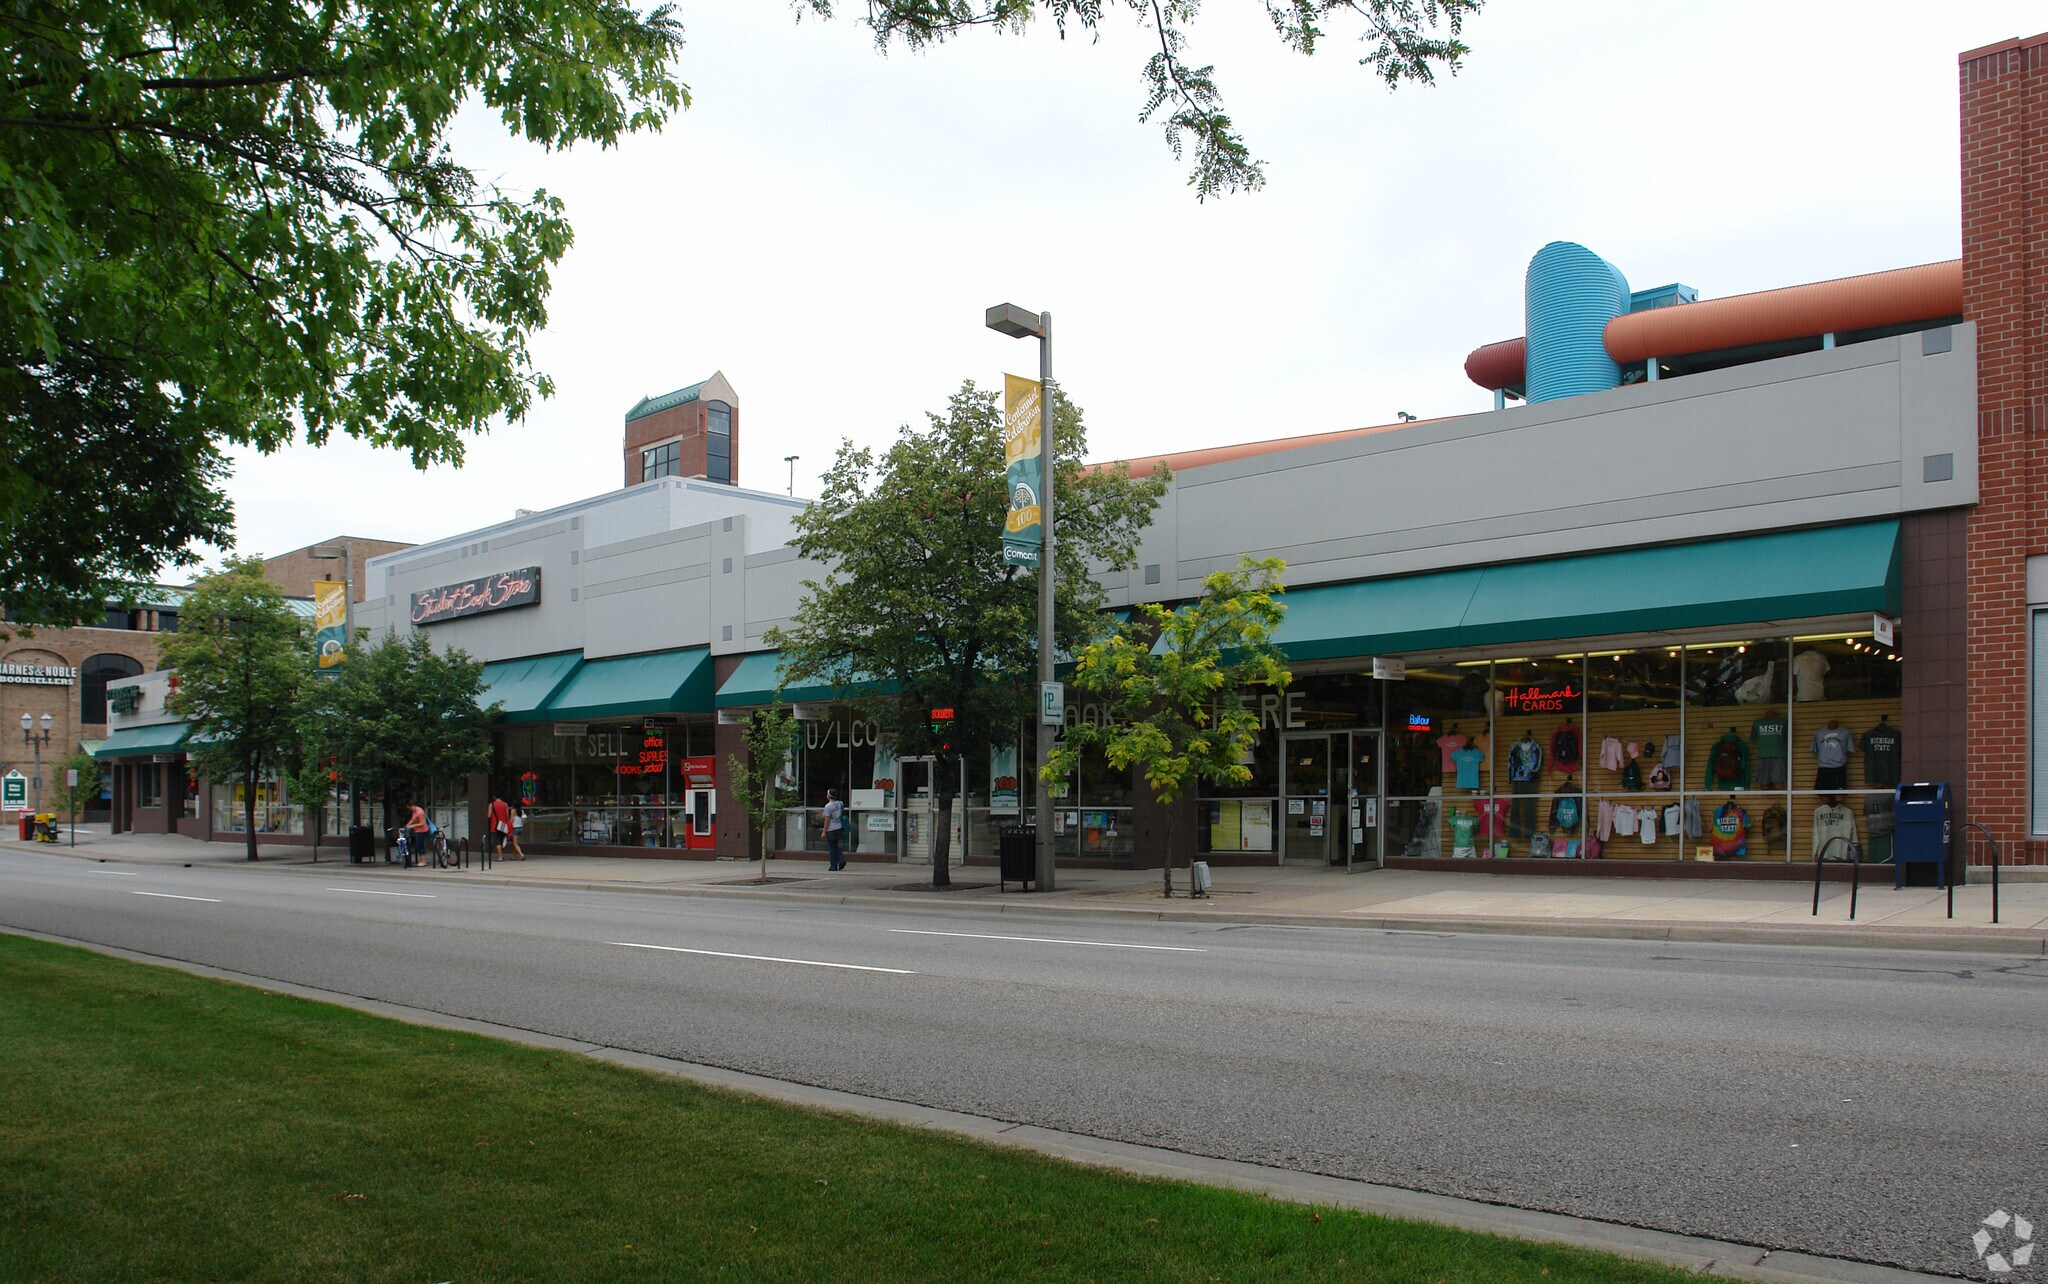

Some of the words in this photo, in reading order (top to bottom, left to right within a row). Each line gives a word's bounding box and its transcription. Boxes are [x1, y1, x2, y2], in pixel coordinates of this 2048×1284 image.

[1006, 386, 1039, 426] Centennial
[1005, 405, 1040, 442] Celebration
[1016, 508, 1032, 527] 100
[1004, 546, 1037, 560] Comcast
[411, 588, 461, 622] Student
[454, 579, 491, 612] Book
[487, 575, 532, 606] Store
[1504, 685, 1582, 709] Hallmark
[1522, 700, 1563, 712] CARDS
[1409, 713, 1430, 725] Balfour
[1759, 724, 1783, 734] MSU
[540, 736, 568, 760] BUY
[587, 733, 629, 758] SELL
[643, 736, 664, 749] office
[1870, 737, 1896, 746] MICHIGAN
[1873, 744, 1891, 752] STATE
[638, 750, 668, 764] SUPPLIES
[644, 762, 665, 774] school
[994, 776, 1016, 791] 100
